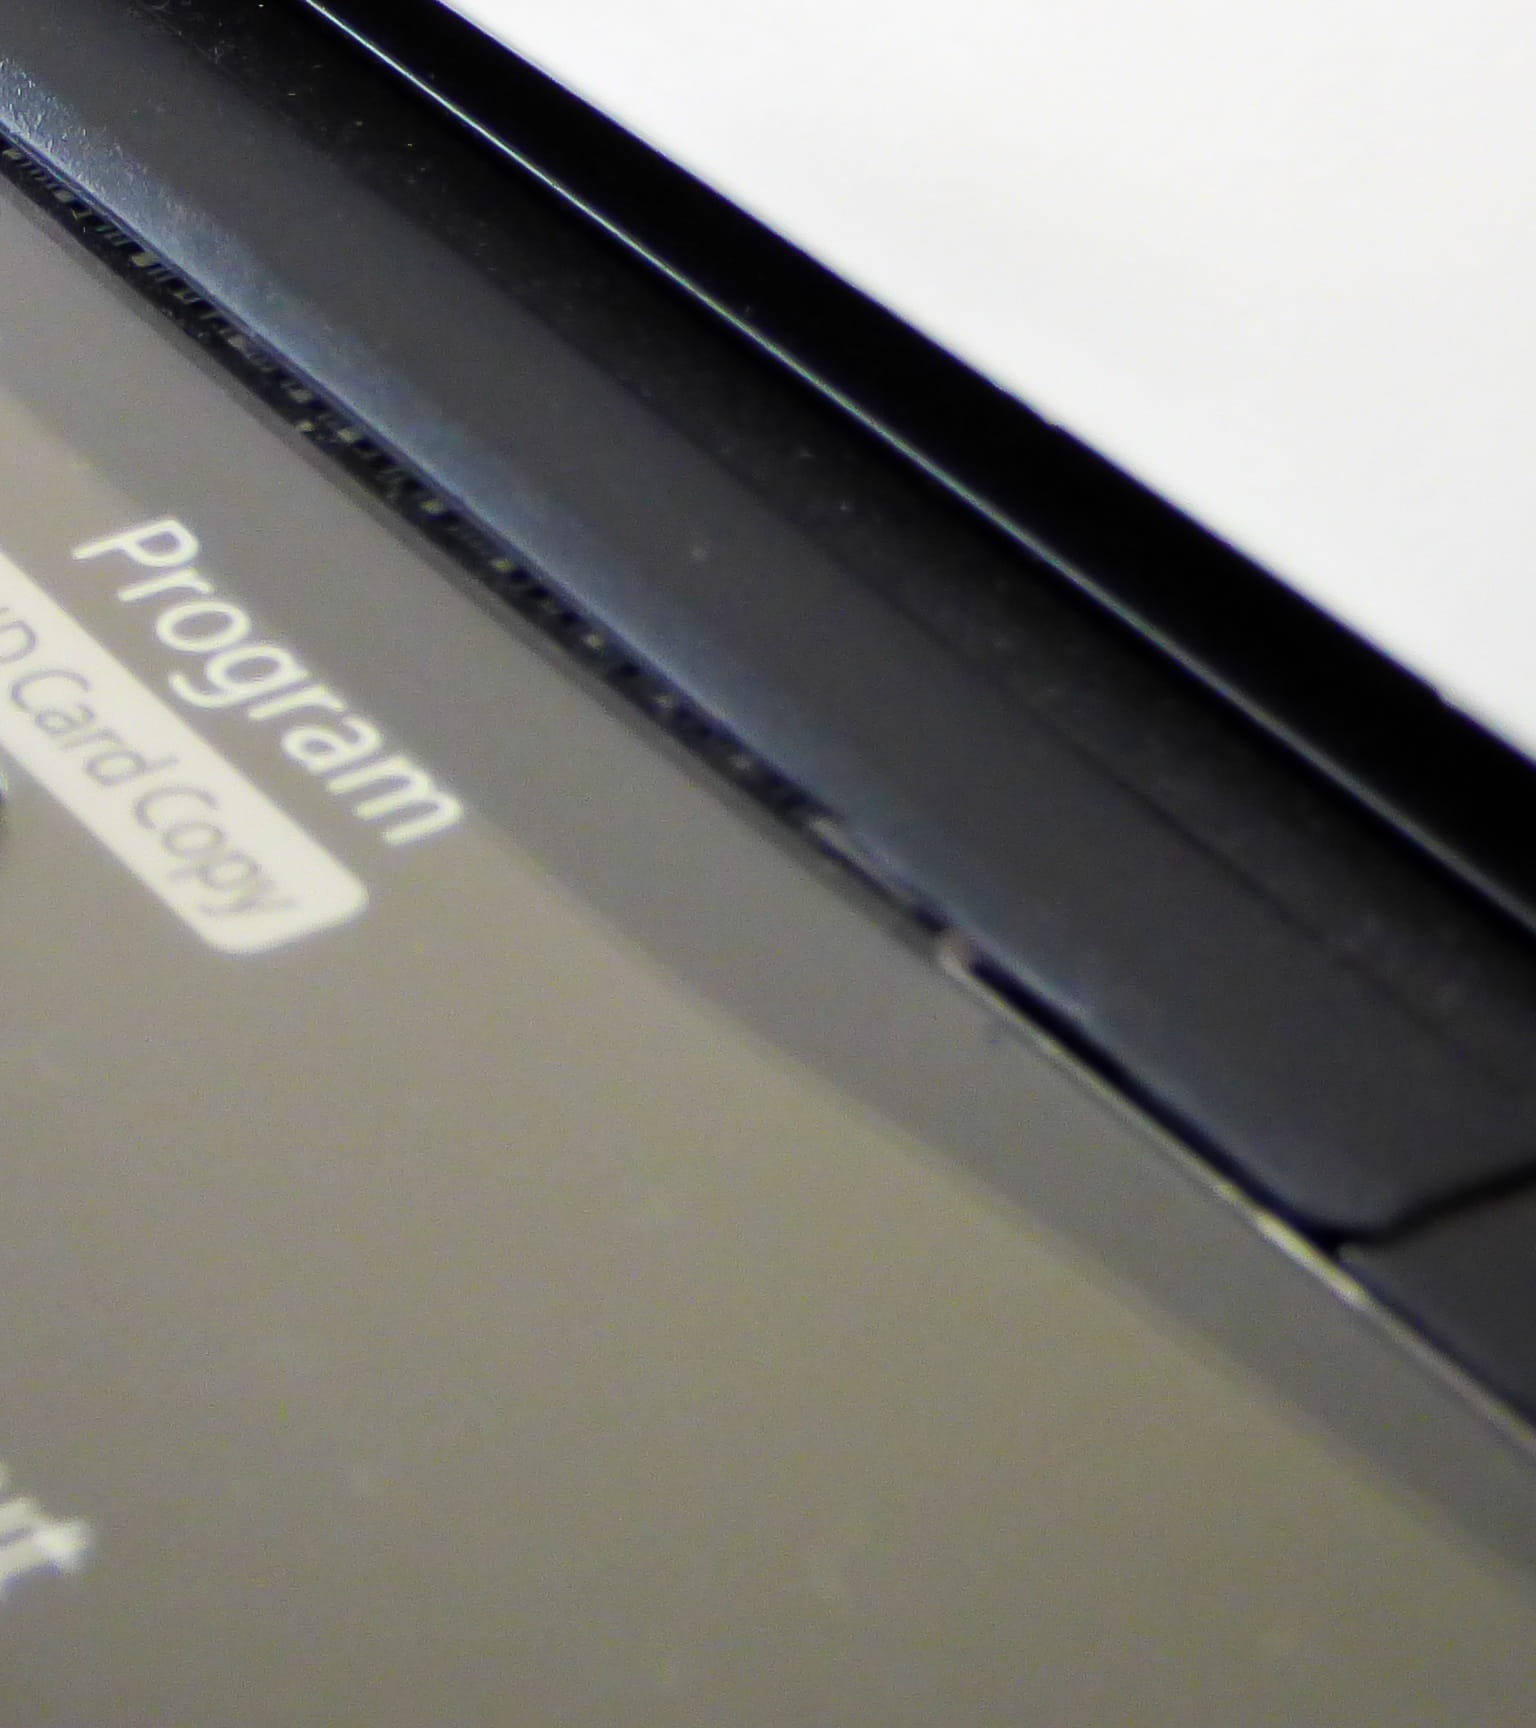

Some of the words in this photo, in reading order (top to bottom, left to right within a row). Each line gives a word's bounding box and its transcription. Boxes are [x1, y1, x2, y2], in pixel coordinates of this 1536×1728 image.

[8, 669, 178, 789] Card
[133, 782, 300, 922] Copy
[71, 518, 465, 847] Program
